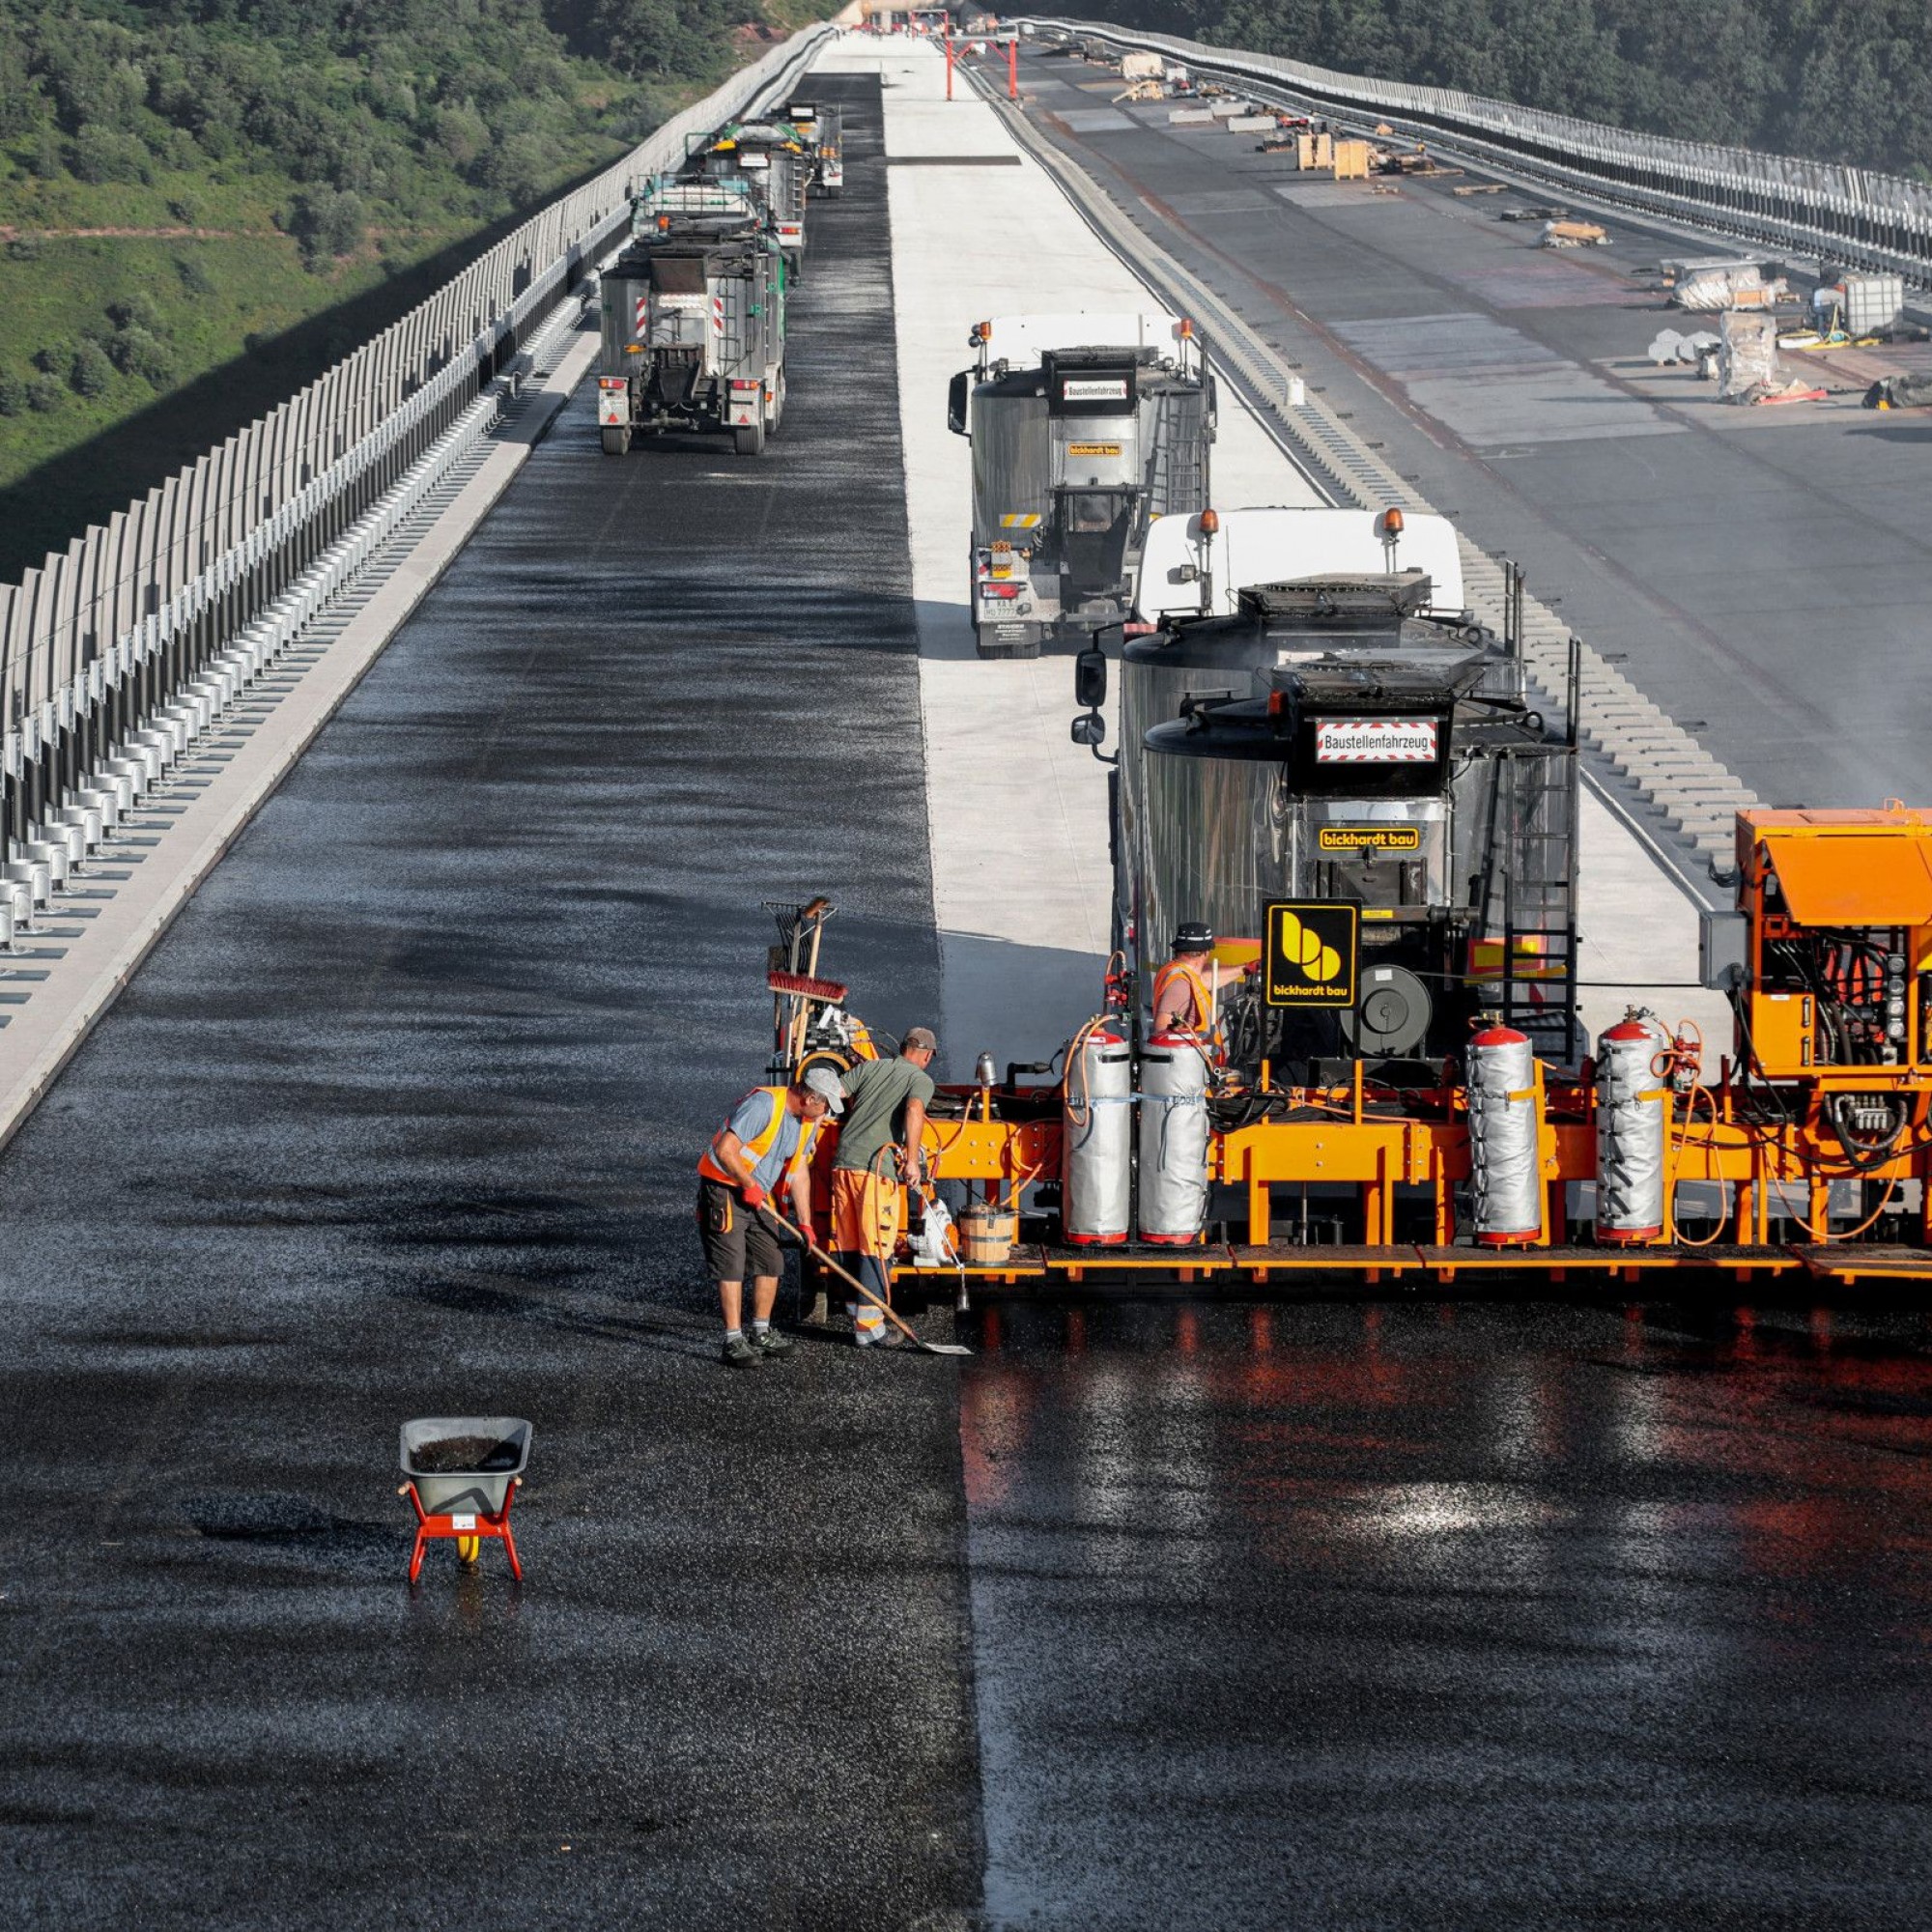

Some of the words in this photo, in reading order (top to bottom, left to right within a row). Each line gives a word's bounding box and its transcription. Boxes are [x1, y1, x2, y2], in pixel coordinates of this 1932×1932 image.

[1068, 386, 1122, 396] Baustellenfahrzeug
[1324, 735, 1429, 752] Baustellenfahrzeug
[1323, 833, 1387, 845] bickhardt
[1389, 833, 1414, 845] bau
[1273, 984, 1325, 996] bickhardt
[1326, 985, 1348, 996] bau
